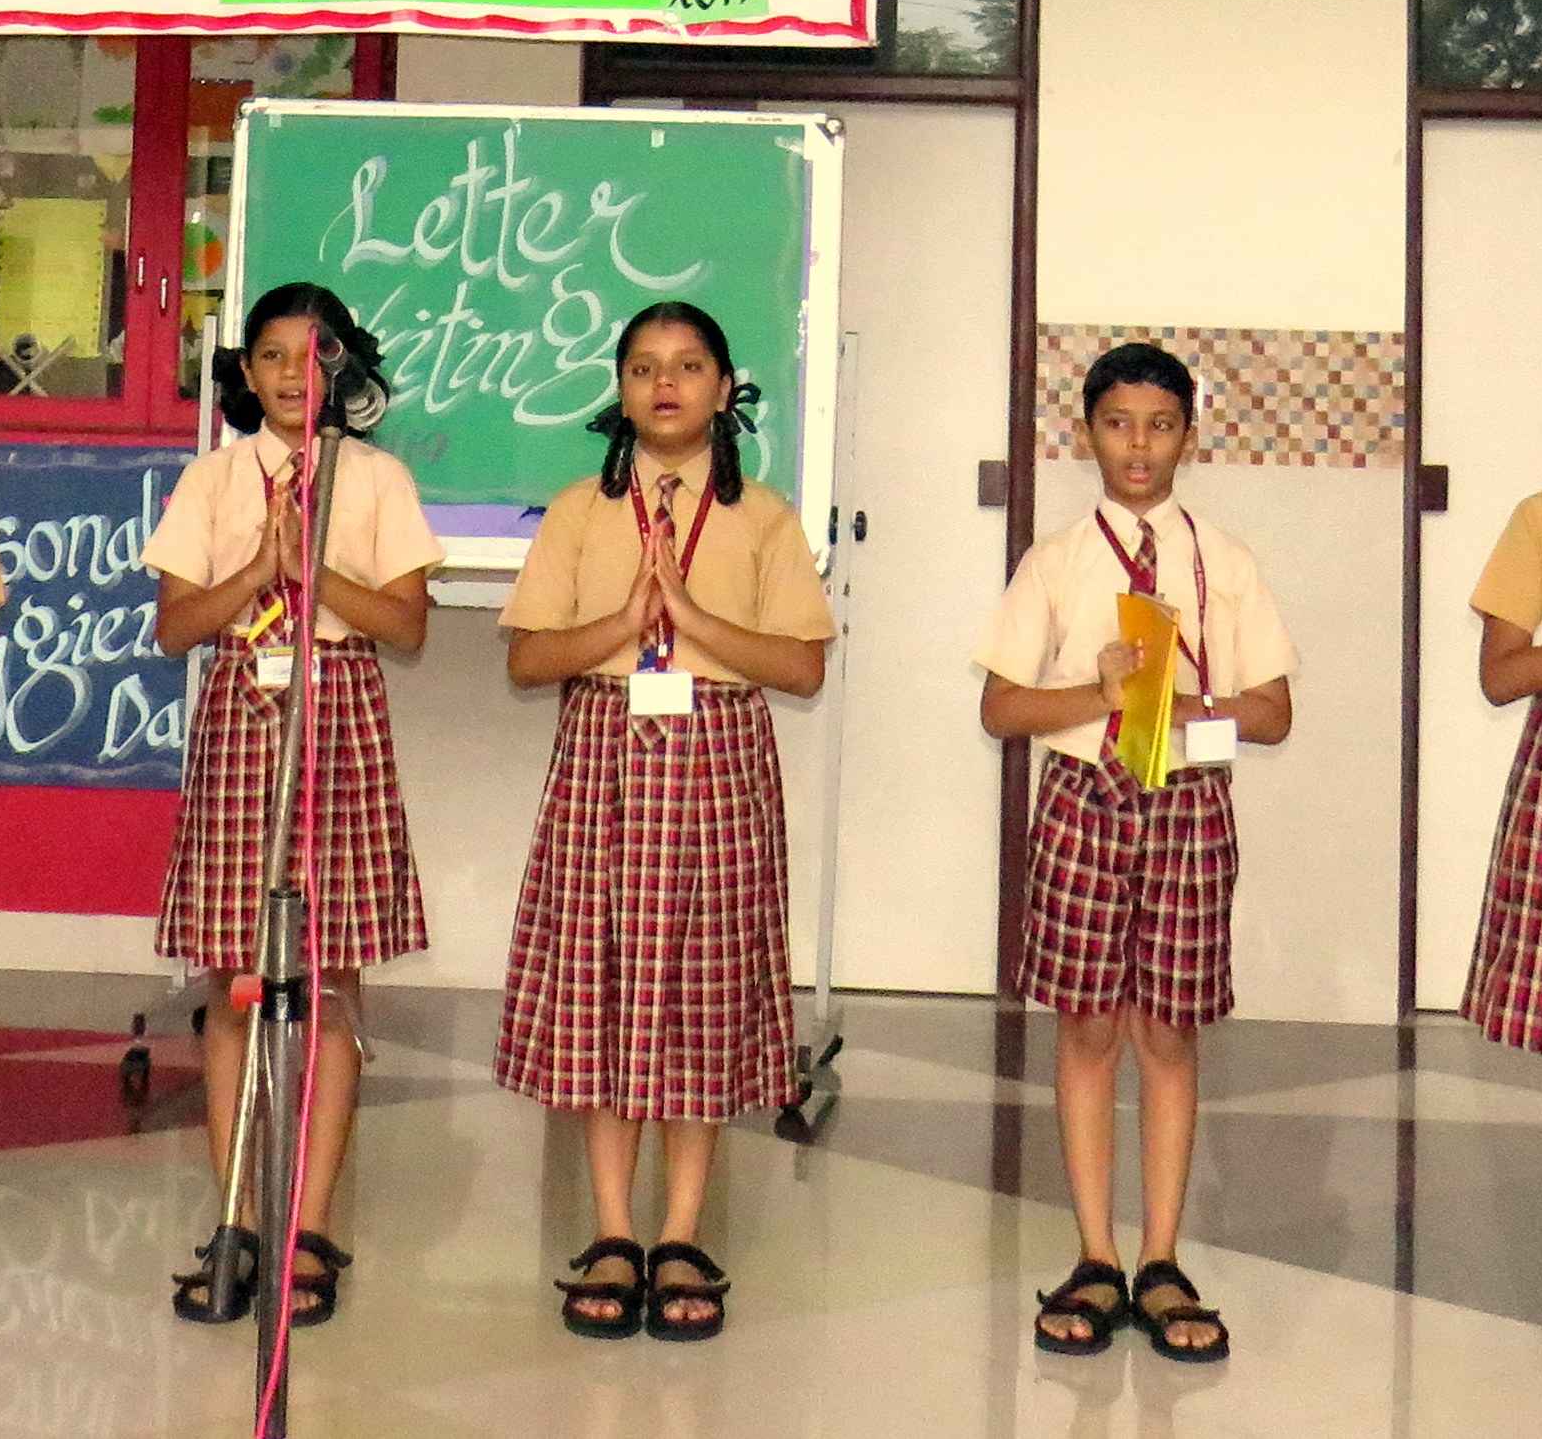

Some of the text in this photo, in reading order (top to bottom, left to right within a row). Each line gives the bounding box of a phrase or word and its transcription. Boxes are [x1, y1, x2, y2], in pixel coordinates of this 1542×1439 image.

[320, 118, 705, 291] Letter
[350, 262, 621, 428] riting
[99, 673, 187, 763] Da
